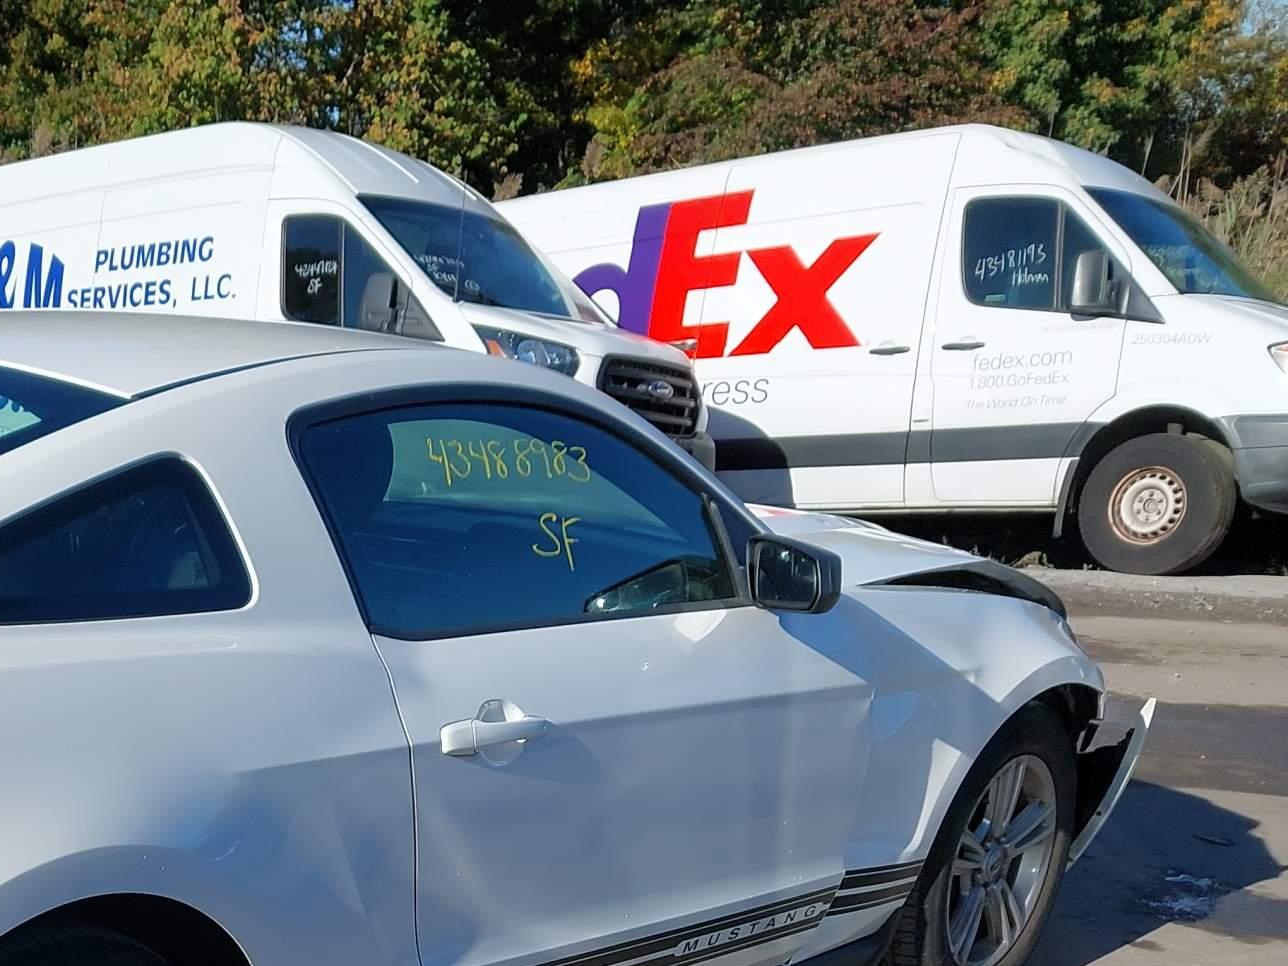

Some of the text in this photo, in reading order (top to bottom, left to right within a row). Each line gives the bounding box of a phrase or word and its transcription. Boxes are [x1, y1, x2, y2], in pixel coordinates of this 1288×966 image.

[95, 236, 215, 273] PLUMBING
[974, 243, 1047, 282] 43481193
[67, 273, 237, 309] SERVICES, LLC.
[970, 370, 1070, 390] 1.800.GoFedEx
[972, 350, 1073, 372] fedex.com
[426, 435, 591, 487] 43488983
[532, 512, 582, 571] SF
[682, 904, 818, 954] MUSTANG
